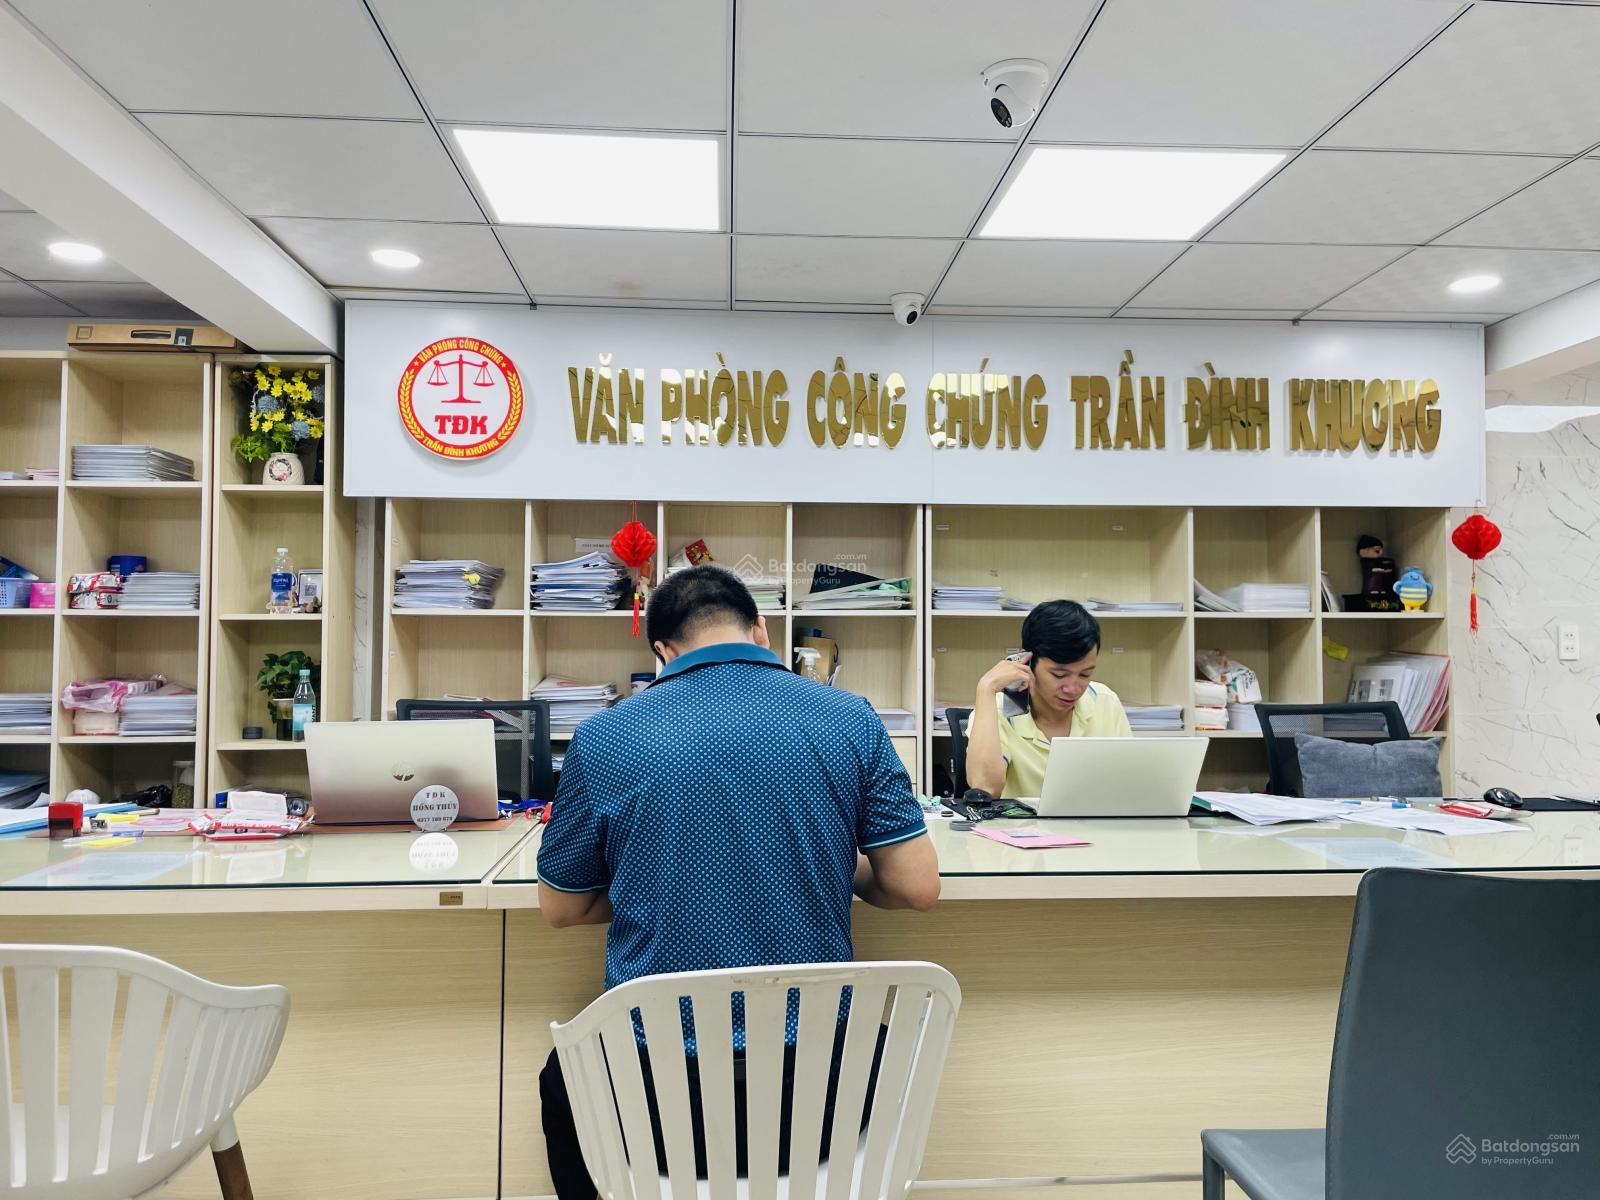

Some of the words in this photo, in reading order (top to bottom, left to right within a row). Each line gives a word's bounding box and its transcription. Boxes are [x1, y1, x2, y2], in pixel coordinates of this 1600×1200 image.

[434, 415, 488, 434] TĐK
[567, 352, 645, 444] VĂN
[660, 351, 790, 447] PHÒNG
[806, 356, 907, 449] CÔNG
[1069, 349, 1166, 450] TRẦN
[1183, 362, 1271, 451] ĐÌNH
